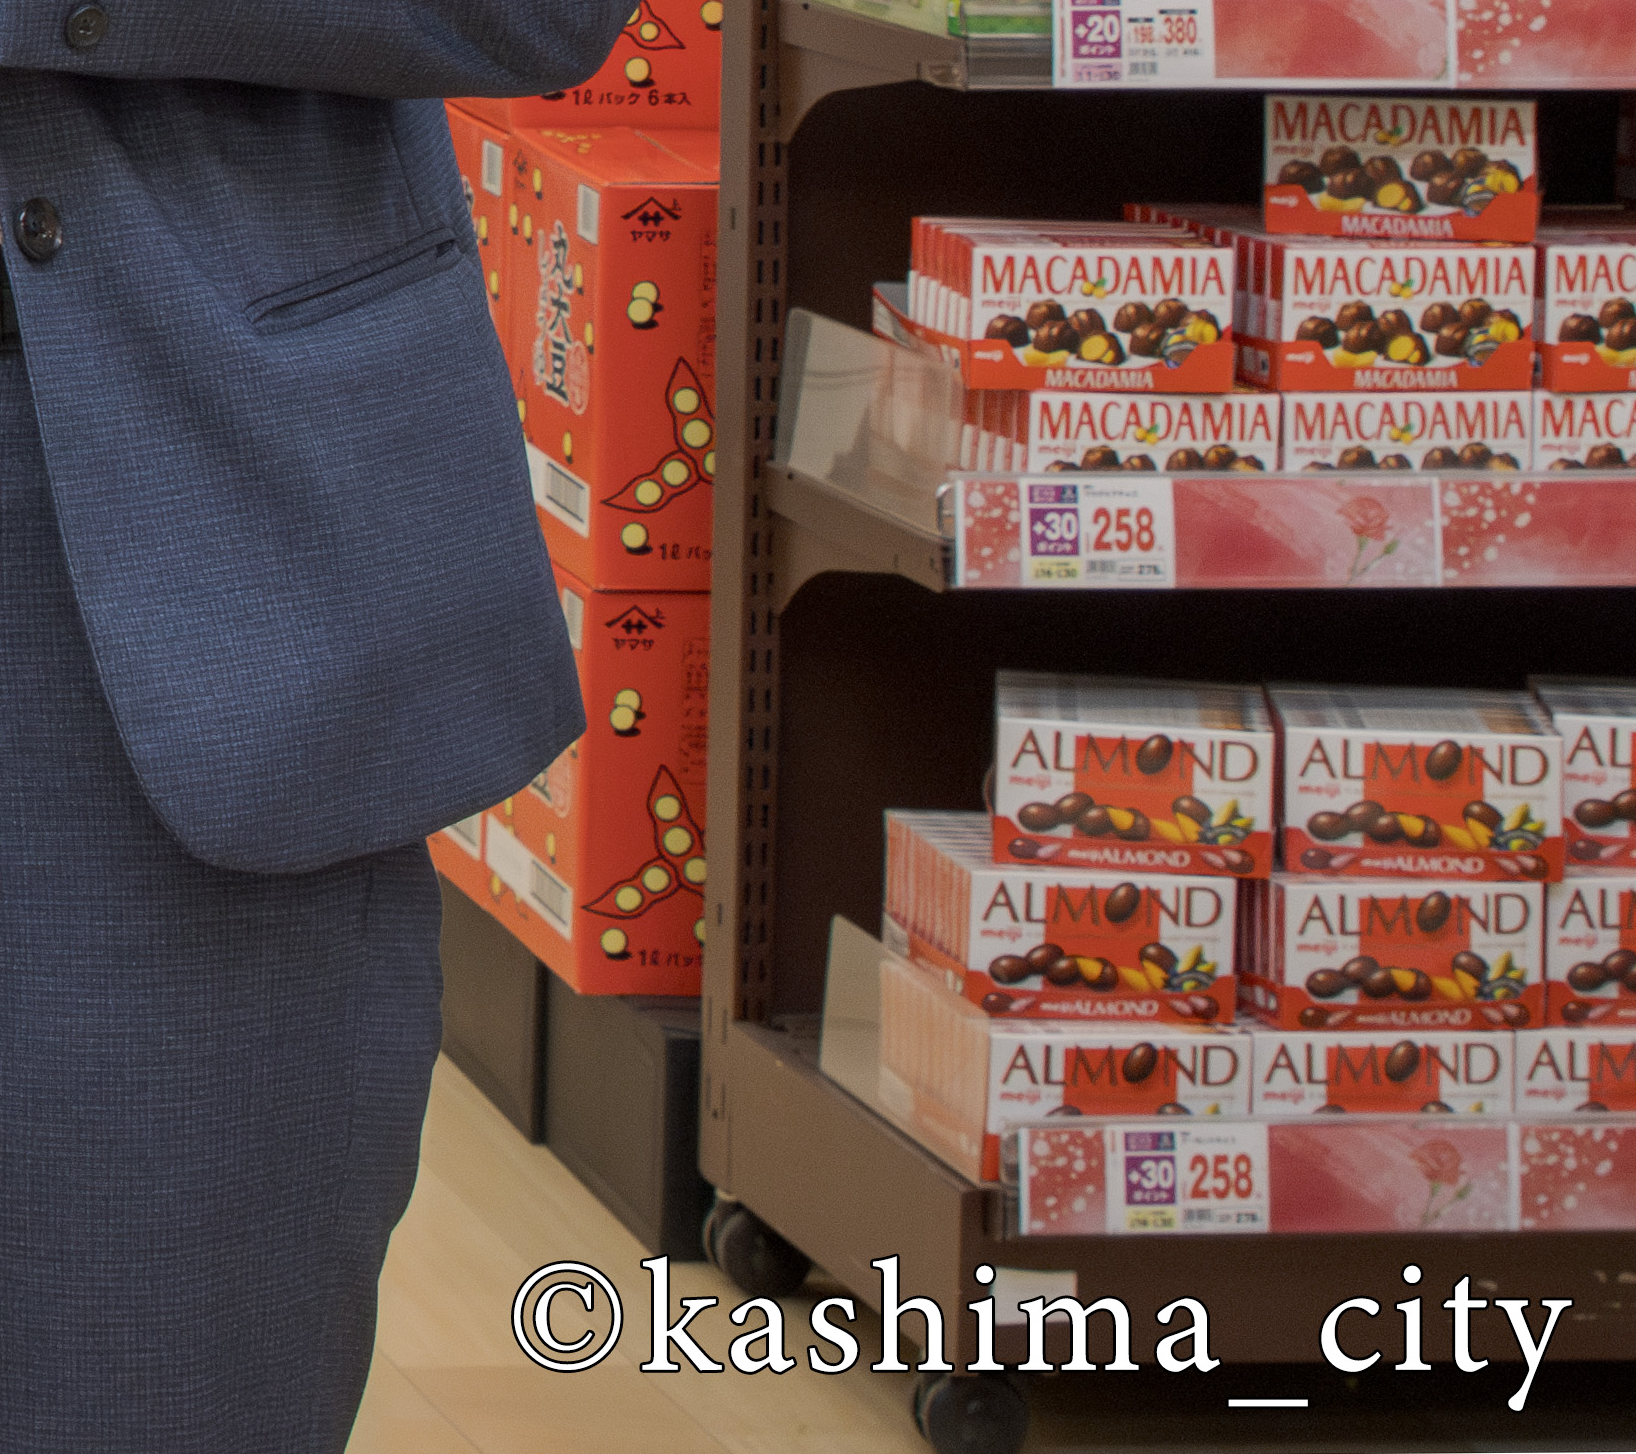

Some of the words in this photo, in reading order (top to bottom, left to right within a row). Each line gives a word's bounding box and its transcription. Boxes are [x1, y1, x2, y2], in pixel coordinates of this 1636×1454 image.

[1270, 100, 1528, 147] MACADAMIA
[980, 254, 1226, 296] MACADAMIA
[1293, 256, 1527, 296] MACADAMIA
[1093, 507, 1155, 552] 258
[1189, 1153, 1253, 1199] 258
